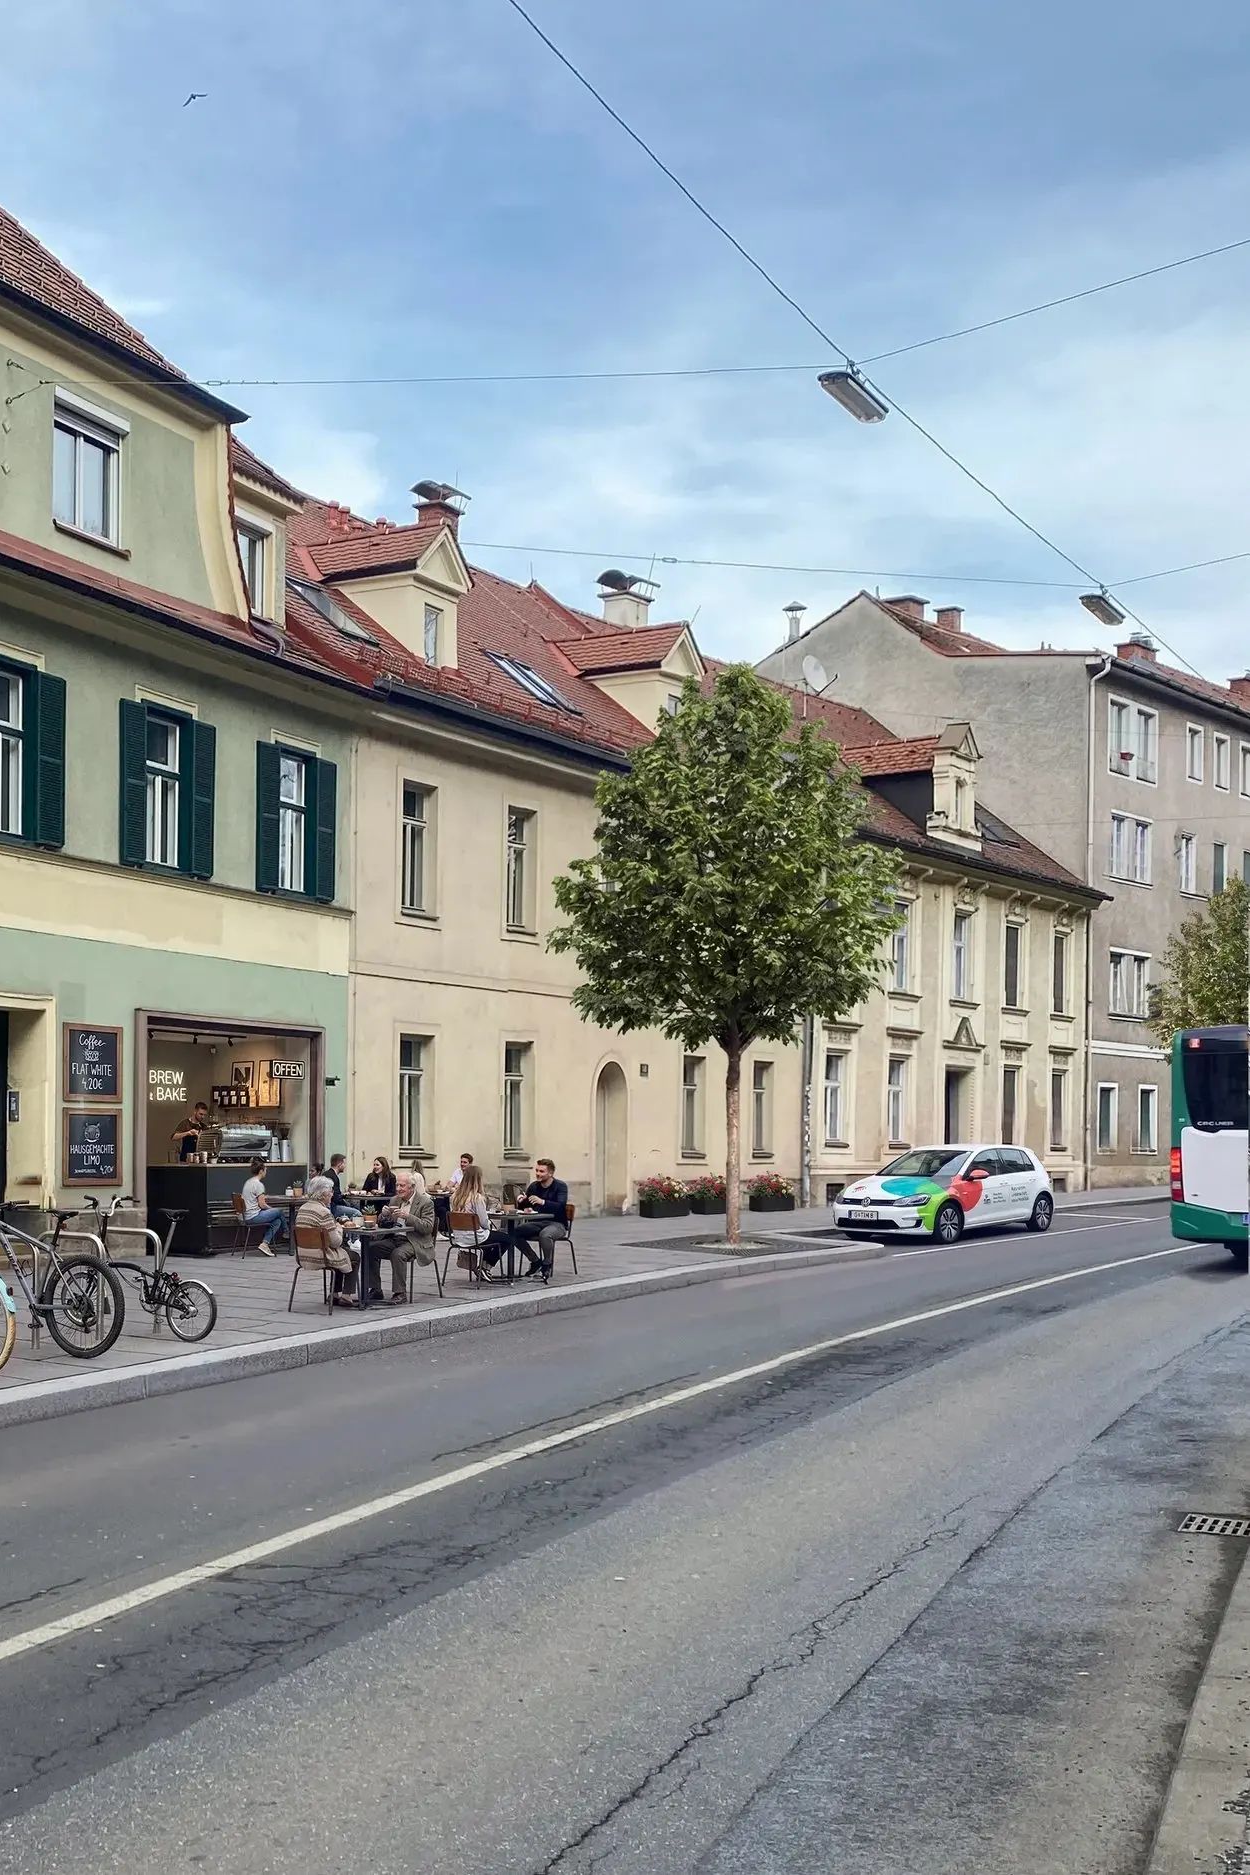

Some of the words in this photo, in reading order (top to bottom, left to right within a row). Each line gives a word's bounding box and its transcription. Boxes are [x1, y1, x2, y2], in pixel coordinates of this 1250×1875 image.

[79, 1033, 106, 1050] Coffee
[71, 1062, 89, 1075] FLAT
[90, 1063, 112, 1076] WHITE
[274, 1063, 303, 1077] OFFEN
[149, 1069, 184, 1085] BREW
[156, 1087, 187, 1101] BAKE
[70, 1144, 115, 1154] HAUSGEMACHTE
[83, 1155, 100, 1165] LIMO
